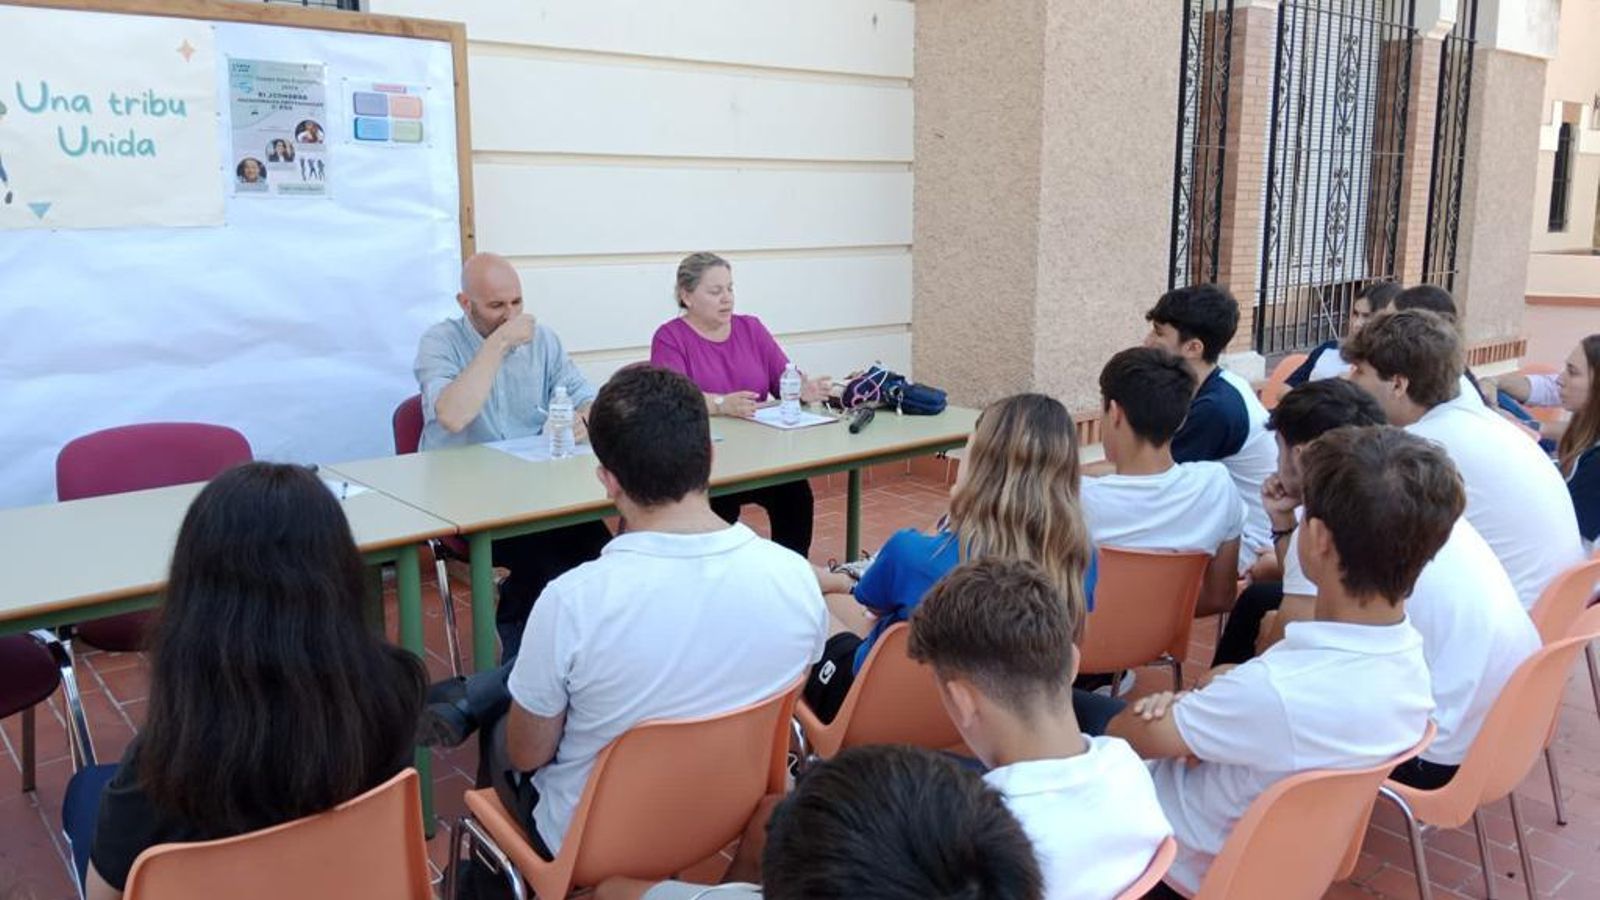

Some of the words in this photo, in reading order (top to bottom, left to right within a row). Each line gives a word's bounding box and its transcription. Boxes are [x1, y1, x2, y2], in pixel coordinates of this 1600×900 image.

[16, 80, 91, 113] Una
[108, 89, 187, 117] tribu
[57, 125, 156, 157] Unida
